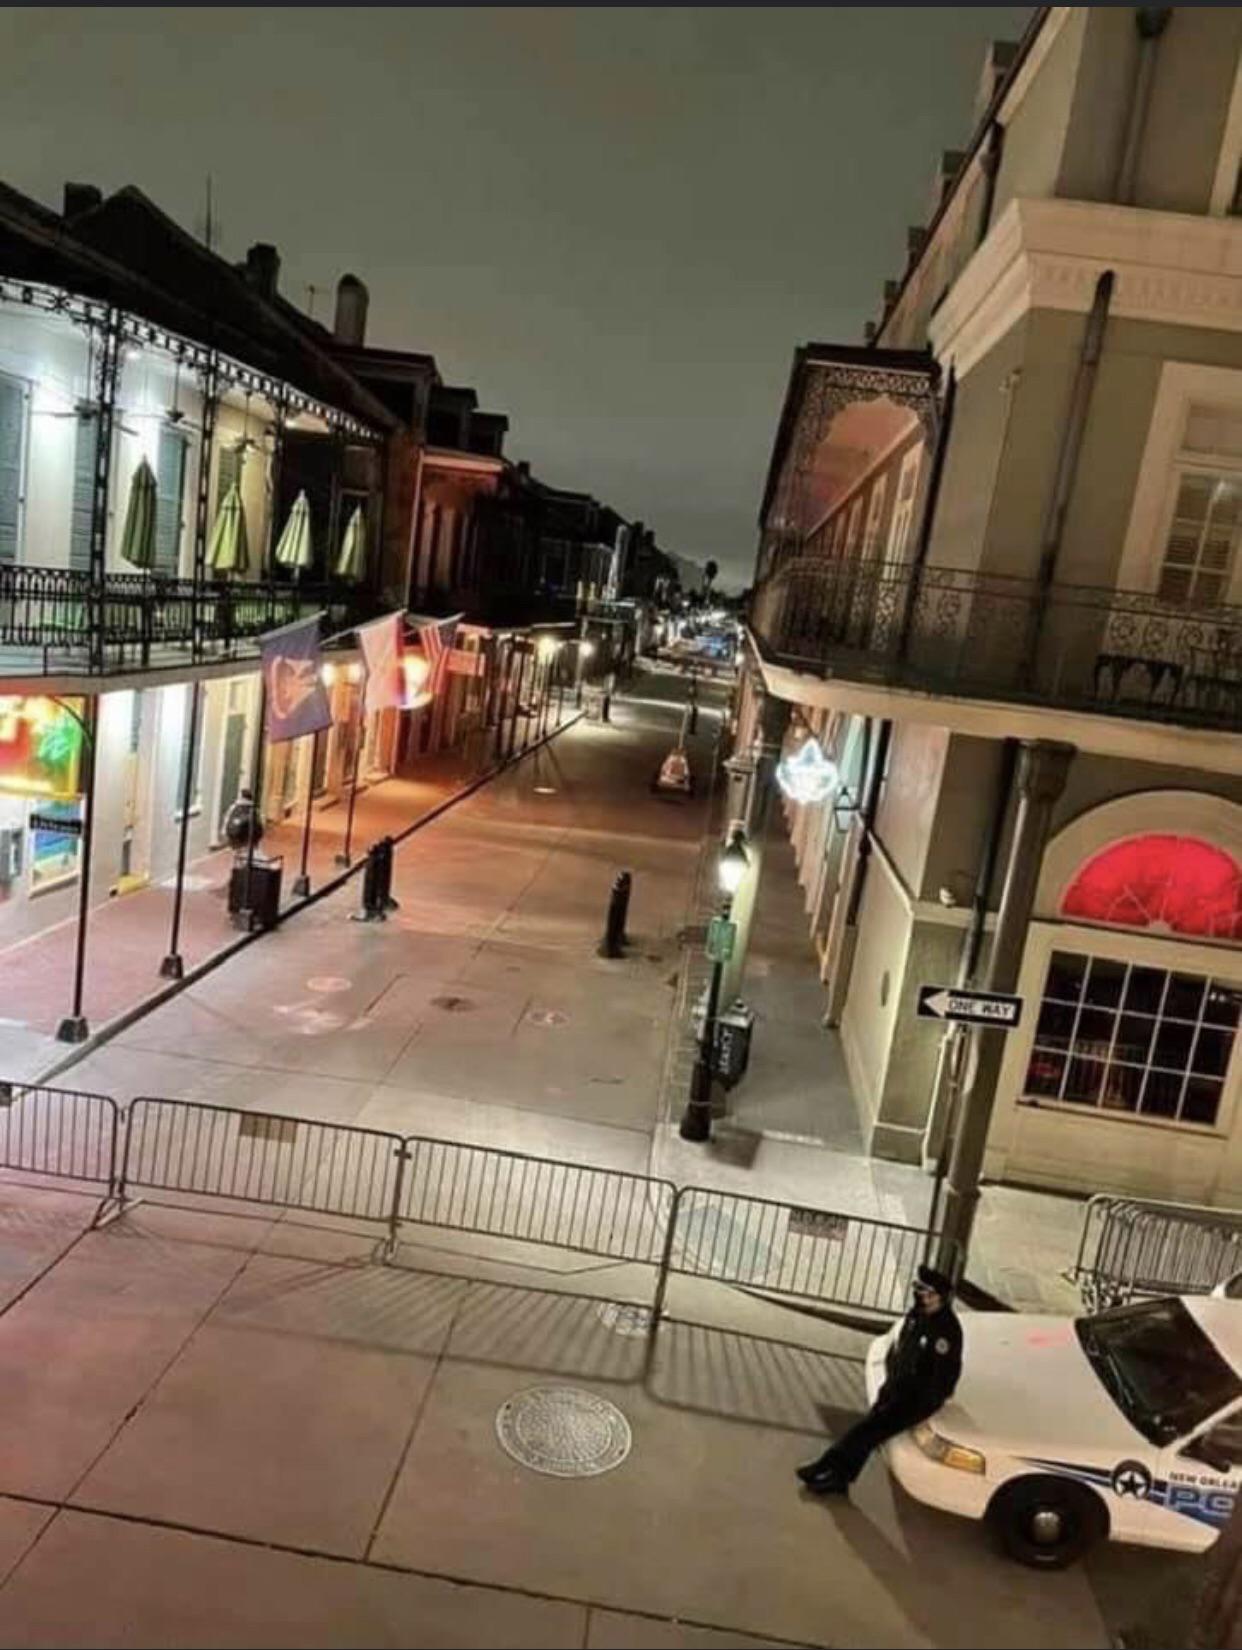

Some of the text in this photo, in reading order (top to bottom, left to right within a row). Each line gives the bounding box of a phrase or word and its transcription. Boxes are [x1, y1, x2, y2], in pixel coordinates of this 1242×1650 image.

[949, 999, 1011, 1016] ONE WAY
[1169, 1472, 1197, 1483] NEW
